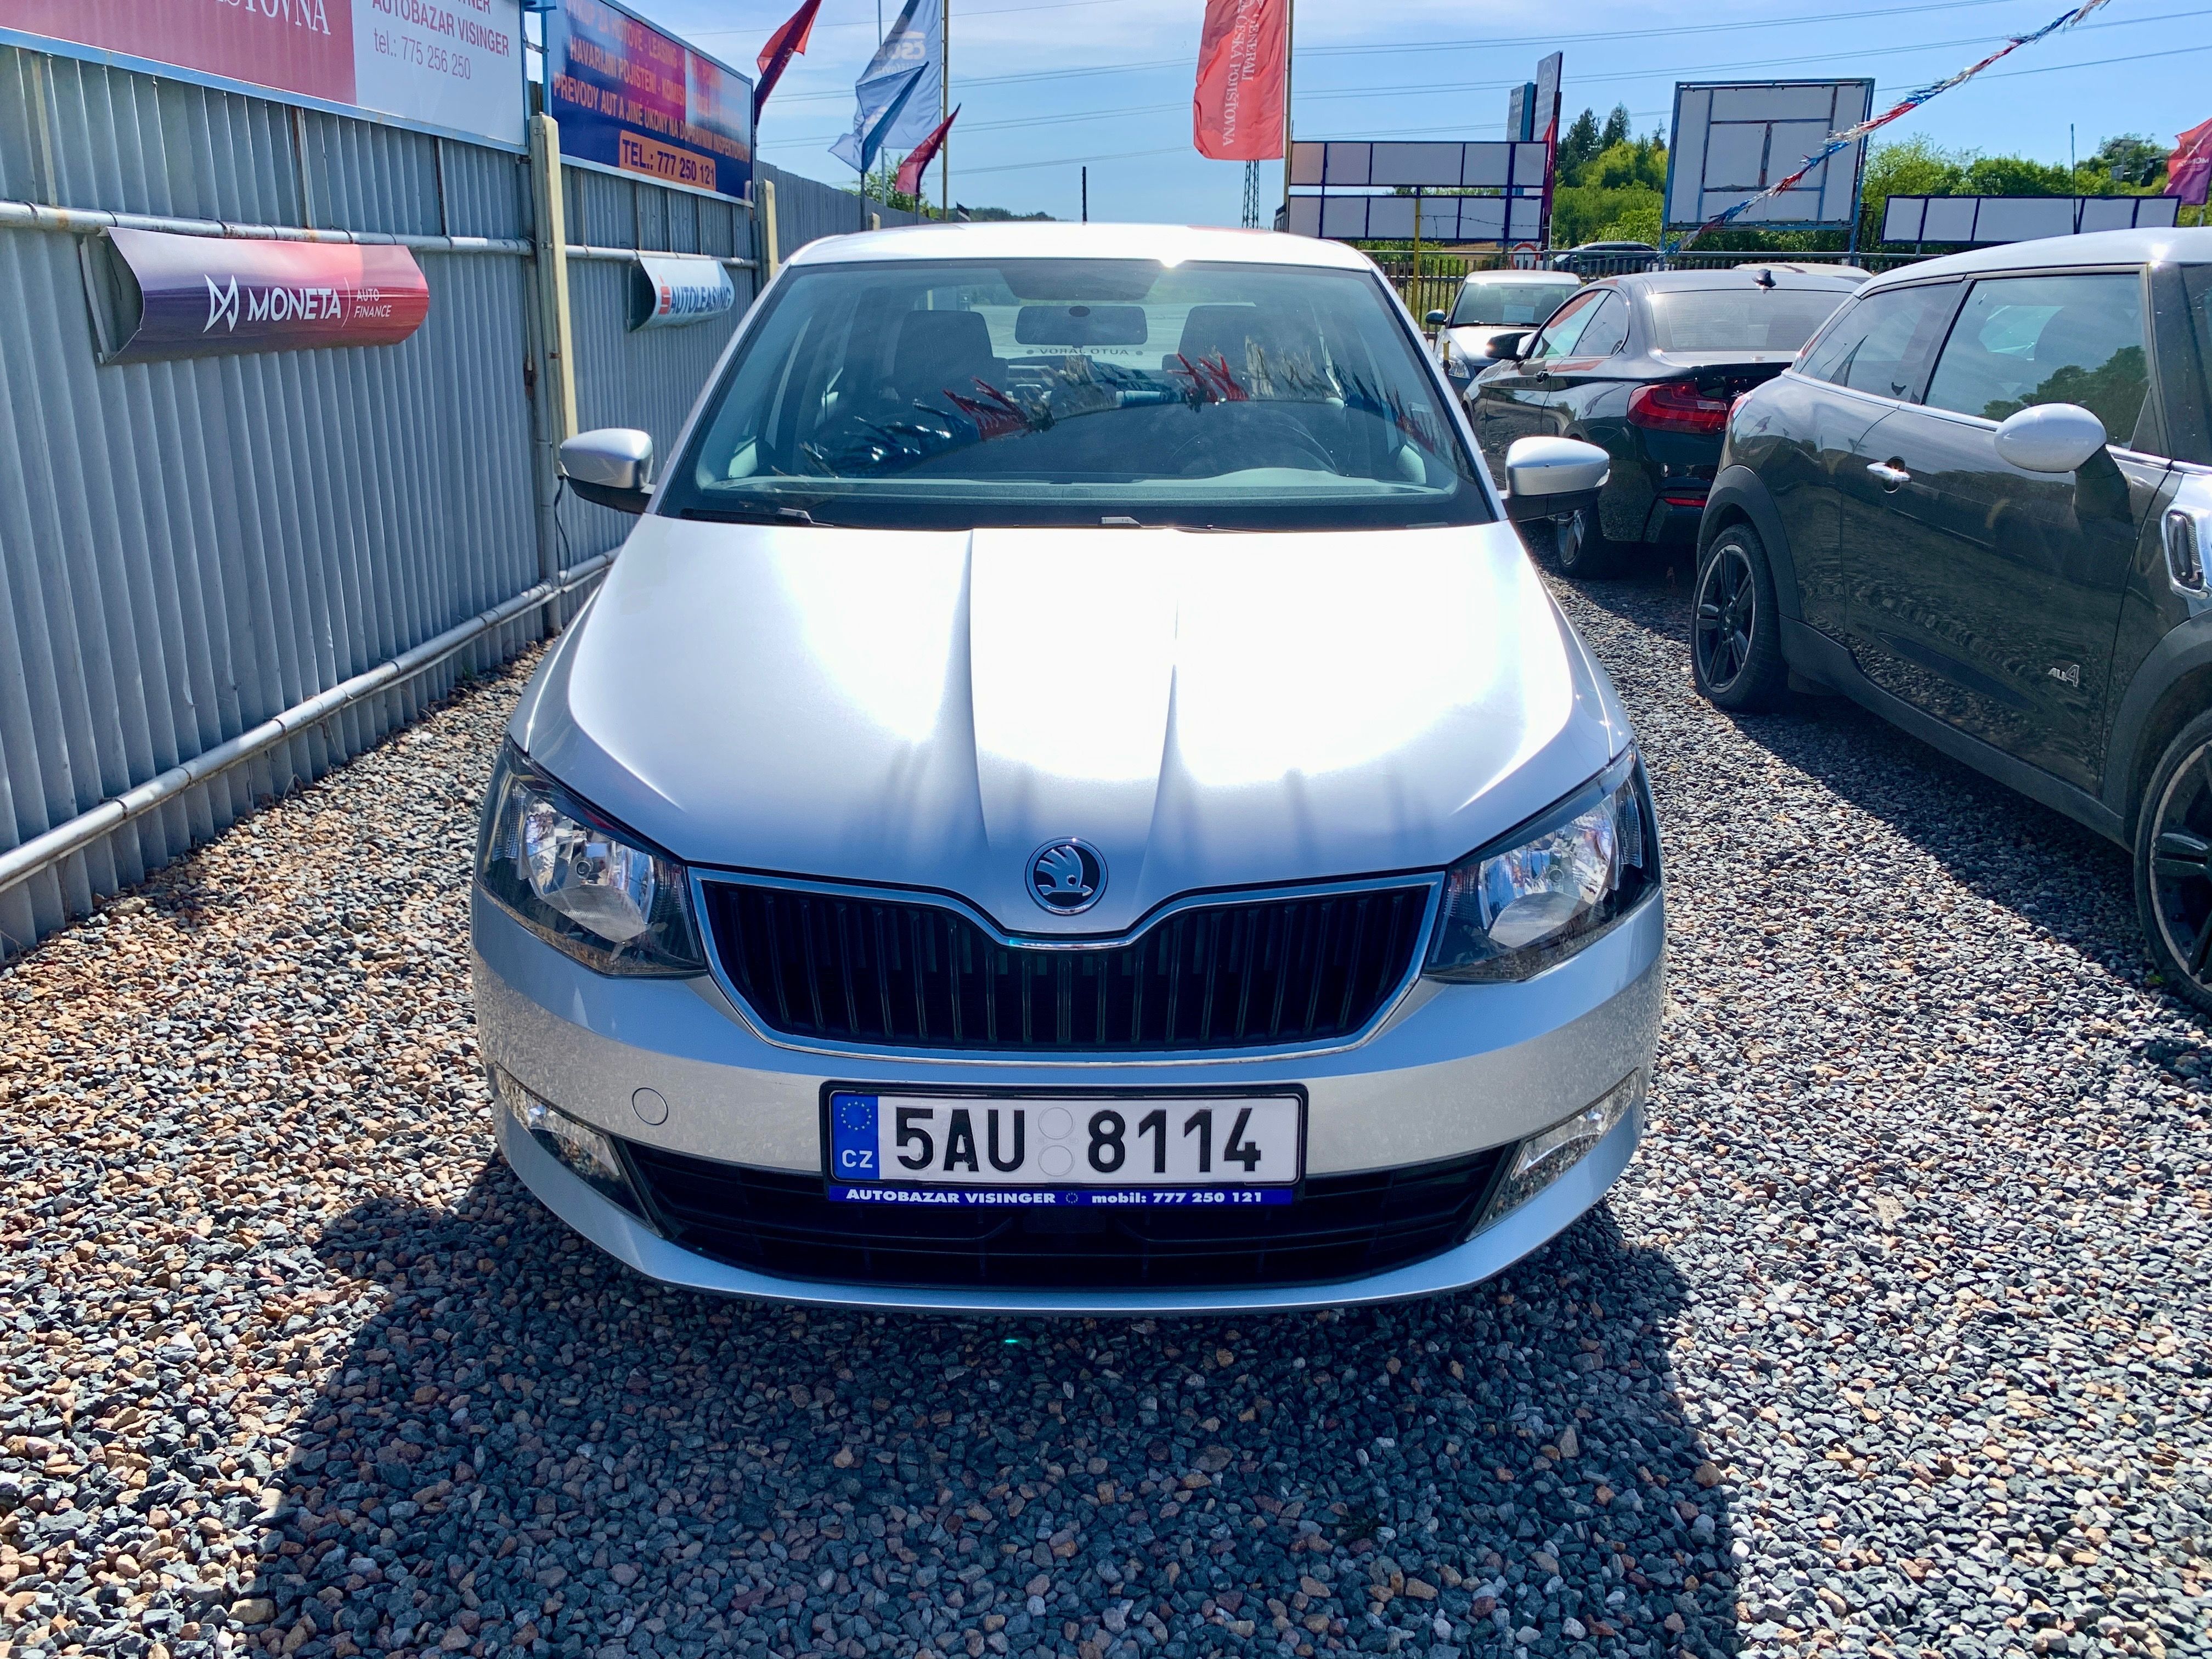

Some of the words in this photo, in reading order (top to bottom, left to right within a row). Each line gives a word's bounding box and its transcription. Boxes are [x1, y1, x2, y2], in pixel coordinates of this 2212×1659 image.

[374, 27, 397, 58] tel.:
[402, 36, 423, 66] 775
[427, 45, 448, 73] 256
[452, 53, 471, 80] 250
[458, 17, 509, 58] VISINGER
[601, 90, 618, 117] AUT
[618, 96, 625, 120] A
[623, 139, 653, 170] TEL.:
[657, 151, 676, 176] 777
[680, 157, 697, 182] 250
[700, 164, 714, 187] 121
[247, 287, 341, 321] MONETA
[354, 304, 392, 318] FINANCE
[356, 289, 380, 301] AUTO
[895, 1107, 1025, 1172] 5AU
[1087, 1108, 1261, 1173] 8114
[842, 1151, 873, 1169] CZ
[846, 1189, 960, 1203] AUTOBAZAR
[964, 1192, 1056, 1204] VISINGER
[1092, 1192, 1147, 1204] mobil:
[1153, 1192, 1187, 1203] 777
[1192, 1192, 1225, 1203] 250
[1232, 1192, 1262, 1203] 121
